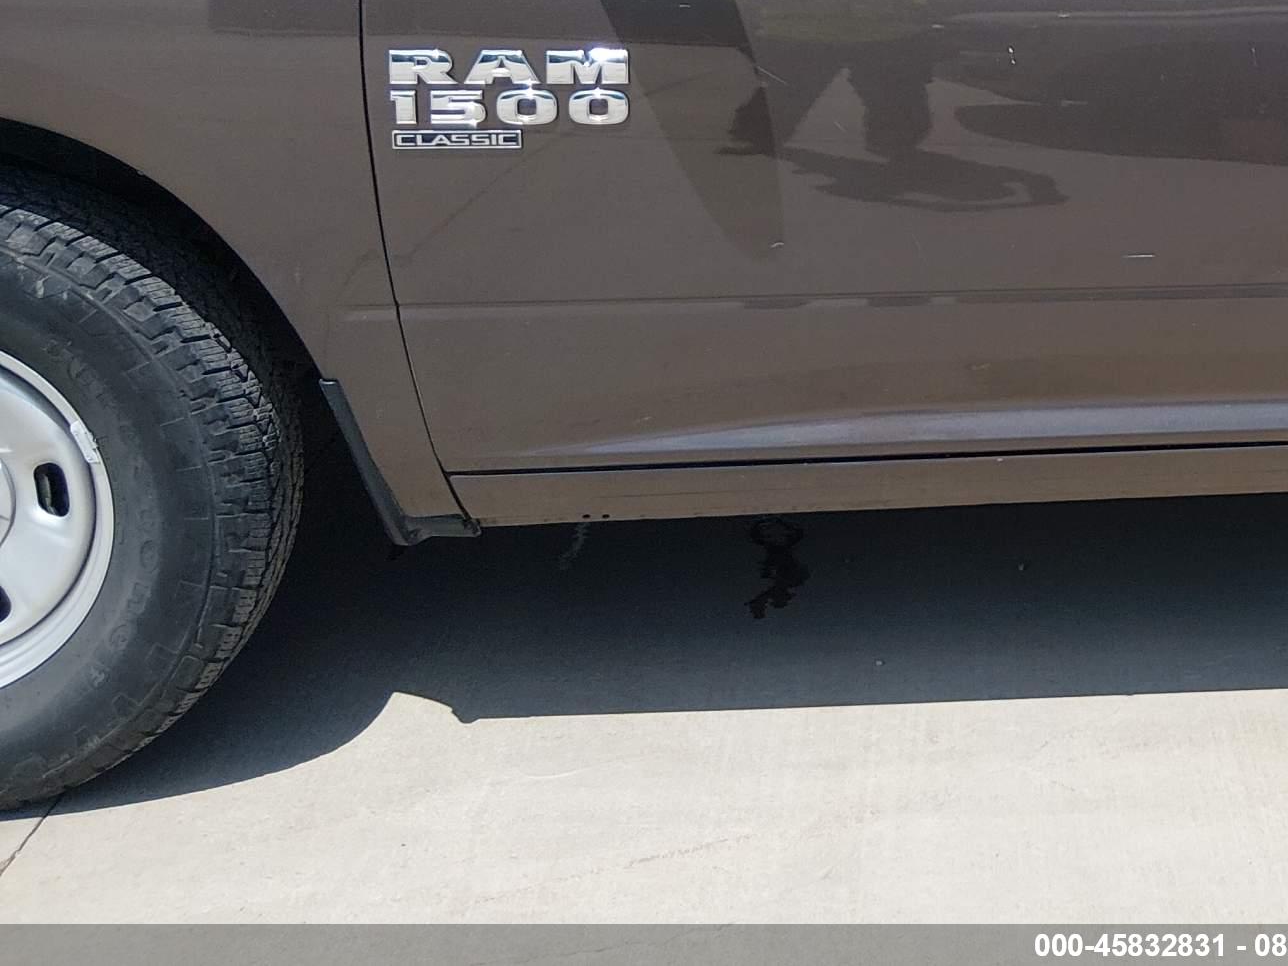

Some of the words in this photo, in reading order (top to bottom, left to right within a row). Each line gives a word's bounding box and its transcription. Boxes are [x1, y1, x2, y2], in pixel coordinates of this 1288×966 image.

[388, 48, 629, 85] RAM
[390, 88, 629, 126] 1500
[395, 133, 519, 146] CLASSIC
